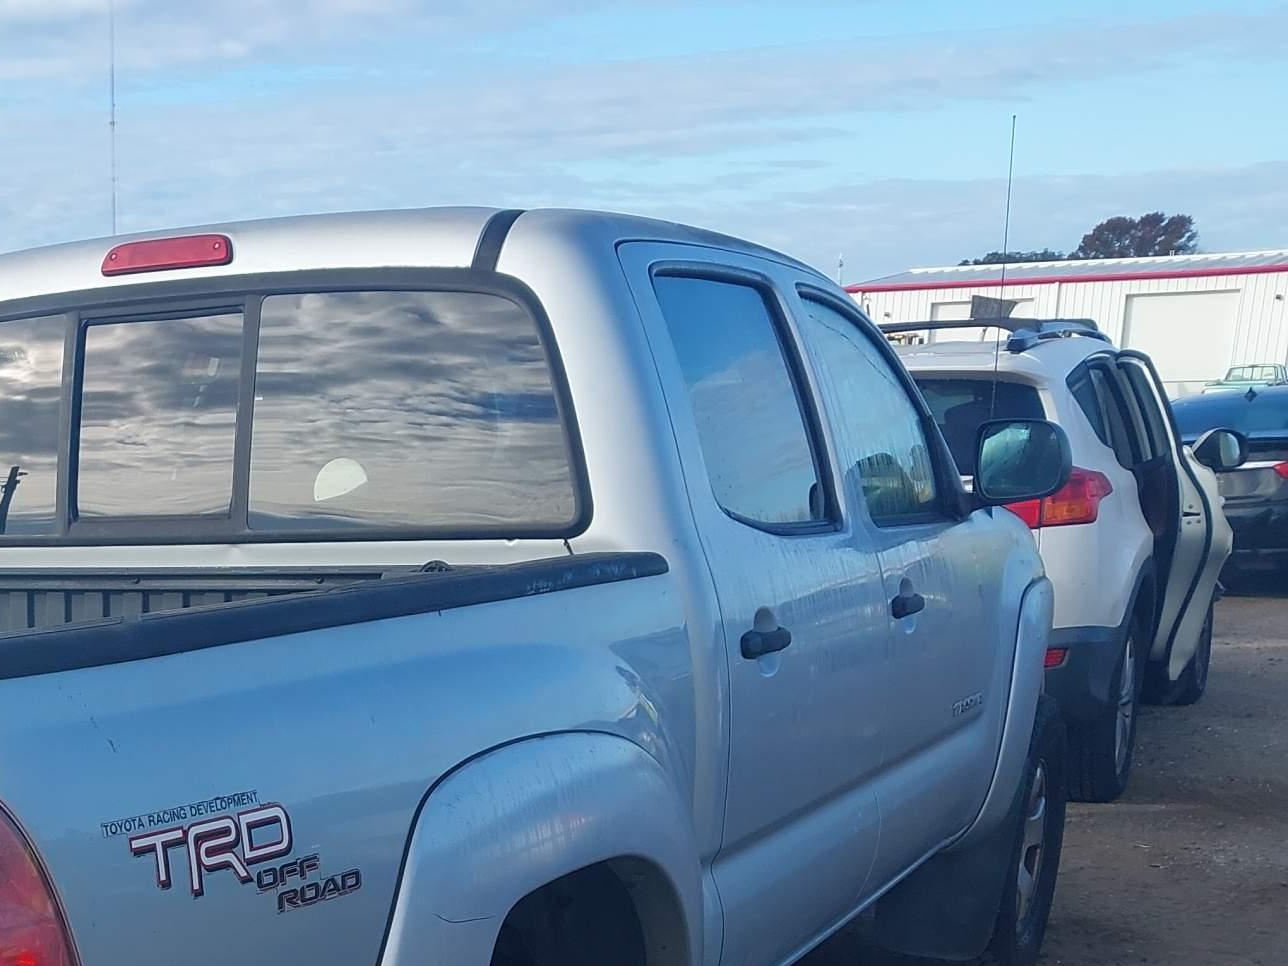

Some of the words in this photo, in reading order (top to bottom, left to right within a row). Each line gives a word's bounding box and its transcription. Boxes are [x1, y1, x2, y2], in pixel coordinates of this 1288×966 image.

[103, 817, 145, 837] TOYOTA
[149, 806, 187, 826] RACING
[189, 791, 258, 817] DEVELOPMENT
[129, 803, 295, 899] TRD
[256, 853, 321, 892] OFF
[277, 867, 363, 913] ROAD
